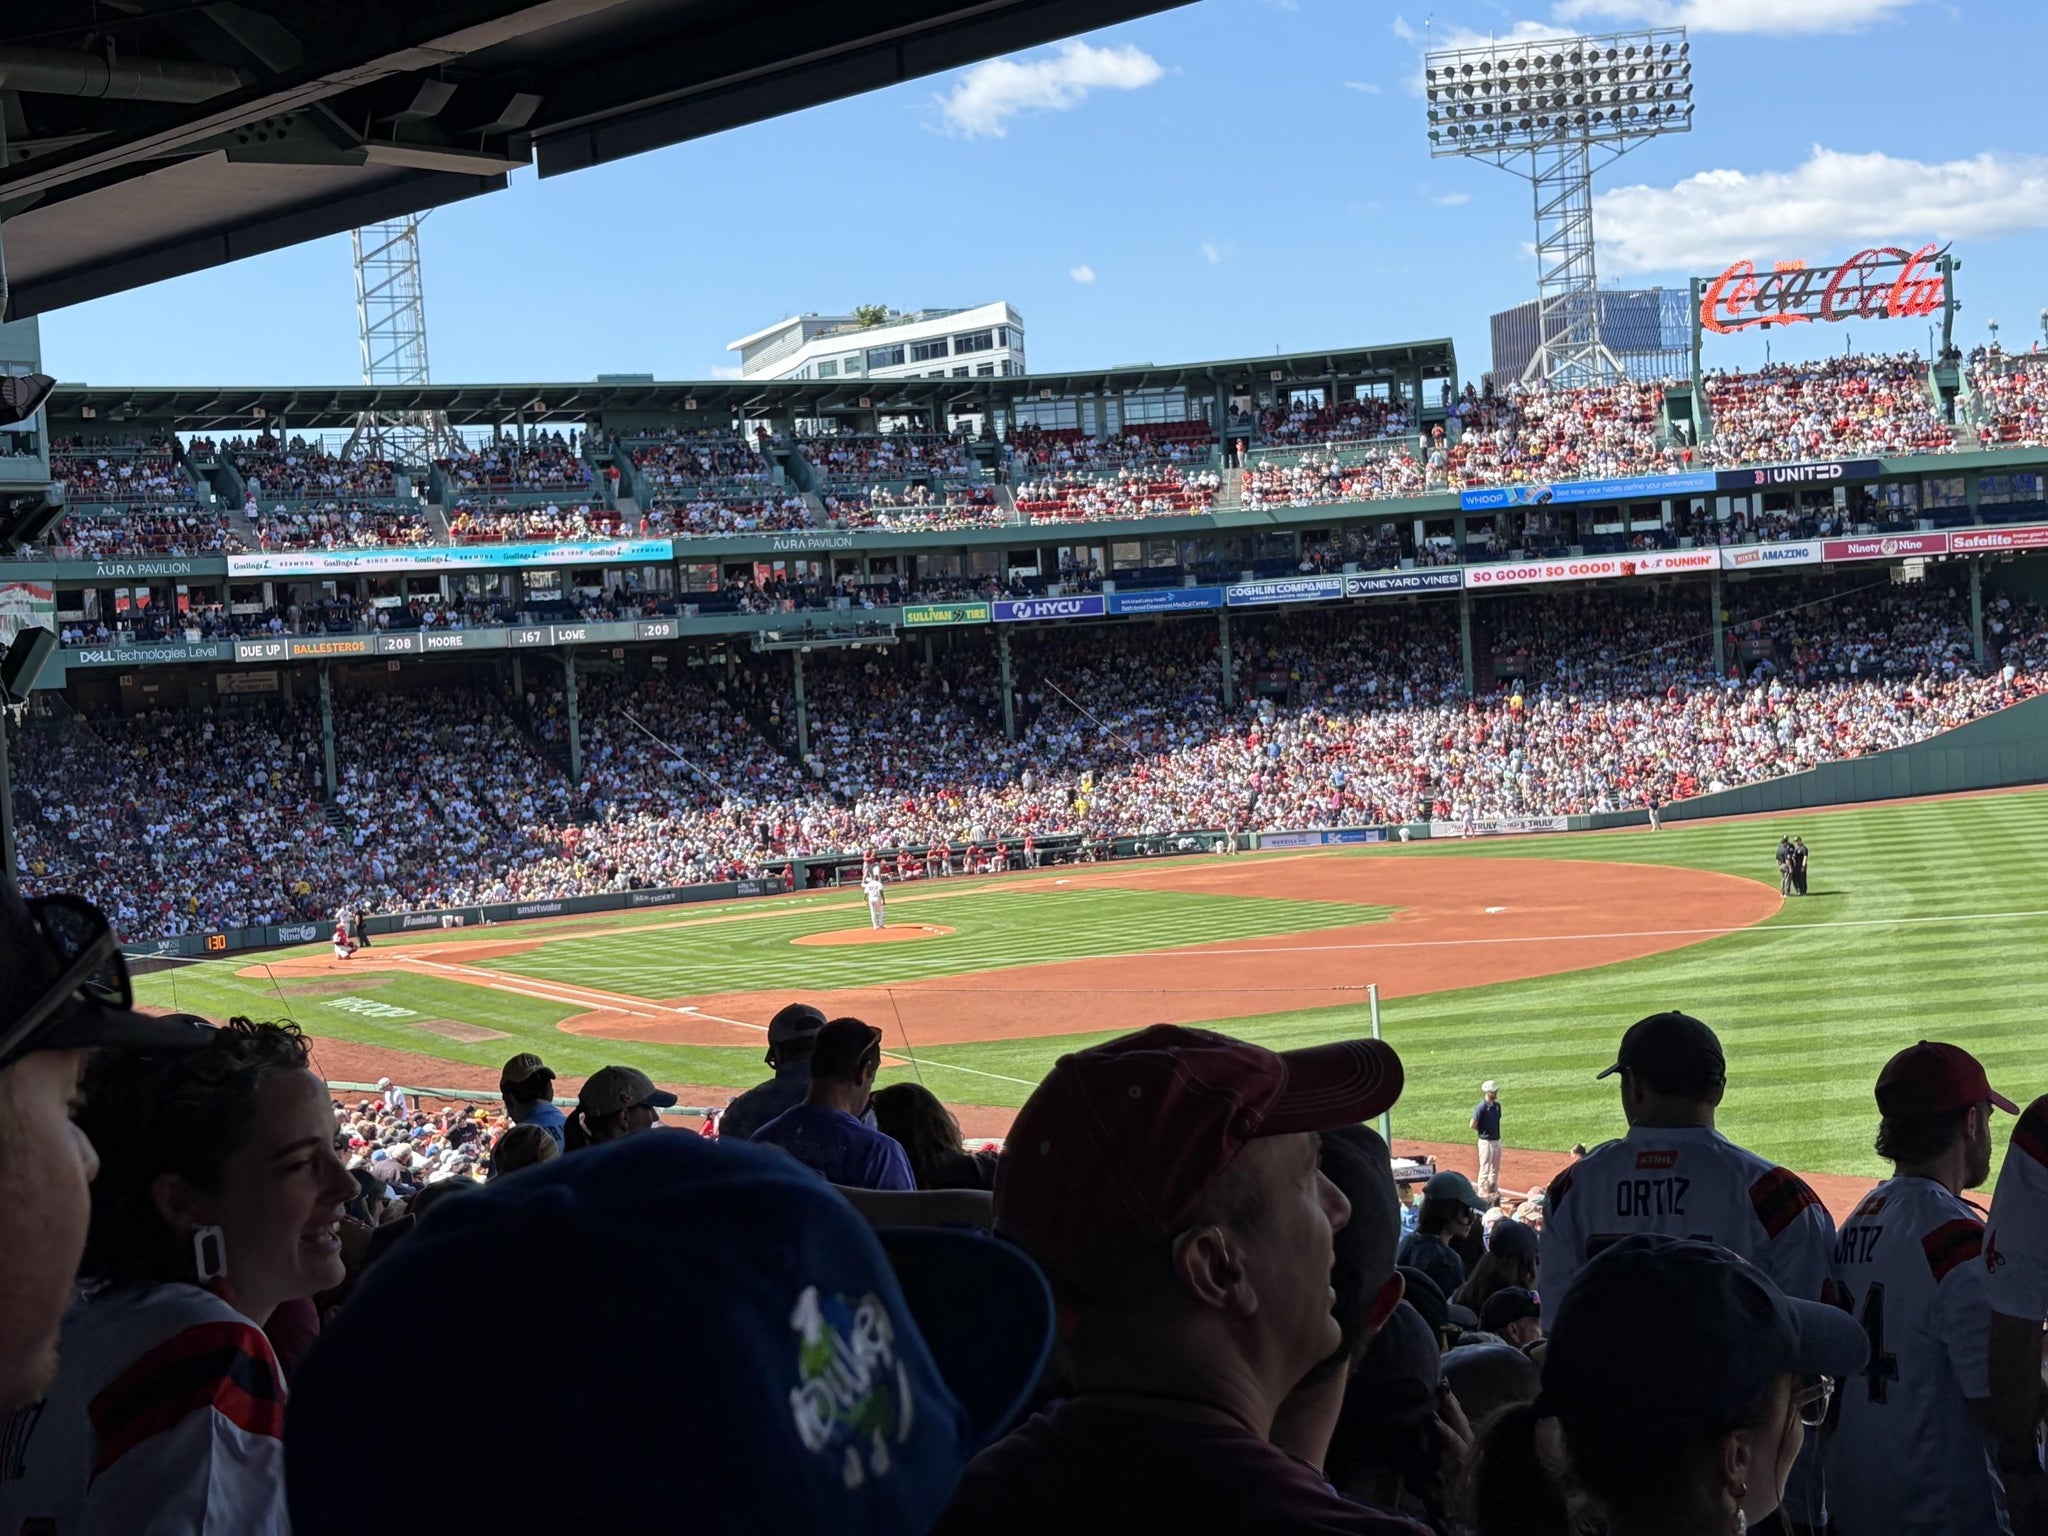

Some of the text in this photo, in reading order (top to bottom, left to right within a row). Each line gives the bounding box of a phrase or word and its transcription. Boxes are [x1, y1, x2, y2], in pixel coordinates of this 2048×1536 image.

[1773, 464, 1843, 483] UNITED
[1646, 482, 1661, 490] your
[1662, 479, 1705, 488] performance
[1465, 493, 1503, 505] WHOOP
[808, 538, 852, 549] PAVILION
[1953, 534, 2012, 548] Safelite
[1847, 541, 1923, 554] Ninety Nine
[1762, 549, 1809, 560] AMAZING
[138, 562, 190, 575] PAVILION
[233, 562, 263, 570] Goslings
[323, 559, 353, 567] Goslings
[1473, 556, 1712, 582] SO GOOD! SO GOOD! DUNKIN'
[1360, 575, 1458, 589] VINEYARD VINES
[1229, 585, 1276, 597] COGHLIN
[1276, 581, 1340, 594] COMPANIES
[1034, 600, 1080, 615] HYCU
[907, 608, 986, 622] SULLIVAN TIRE
[519, 631, 541, 643] .167
[558, 630, 586, 640] LOWE
[644, 625, 670, 637] .209
[293, 641, 366, 654] BALLESTEROS
[384, 638, 412, 650] .208
[428, 635, 464, 648] MOORE
[80, 645, 218, 664] DELL Technologies Level
[240, 644, 281, 657] DUE UP
[1473, 822, 1497, 830] TRULY
[1528, 819, 1553, 827] TRULY
[650, 892, 676, 904] TICKET
[517, 903, 562, 915] smartwater
[279, 933, 300, 942] Nine
[1616, 1177, 1690, 1217] ORTIZ
